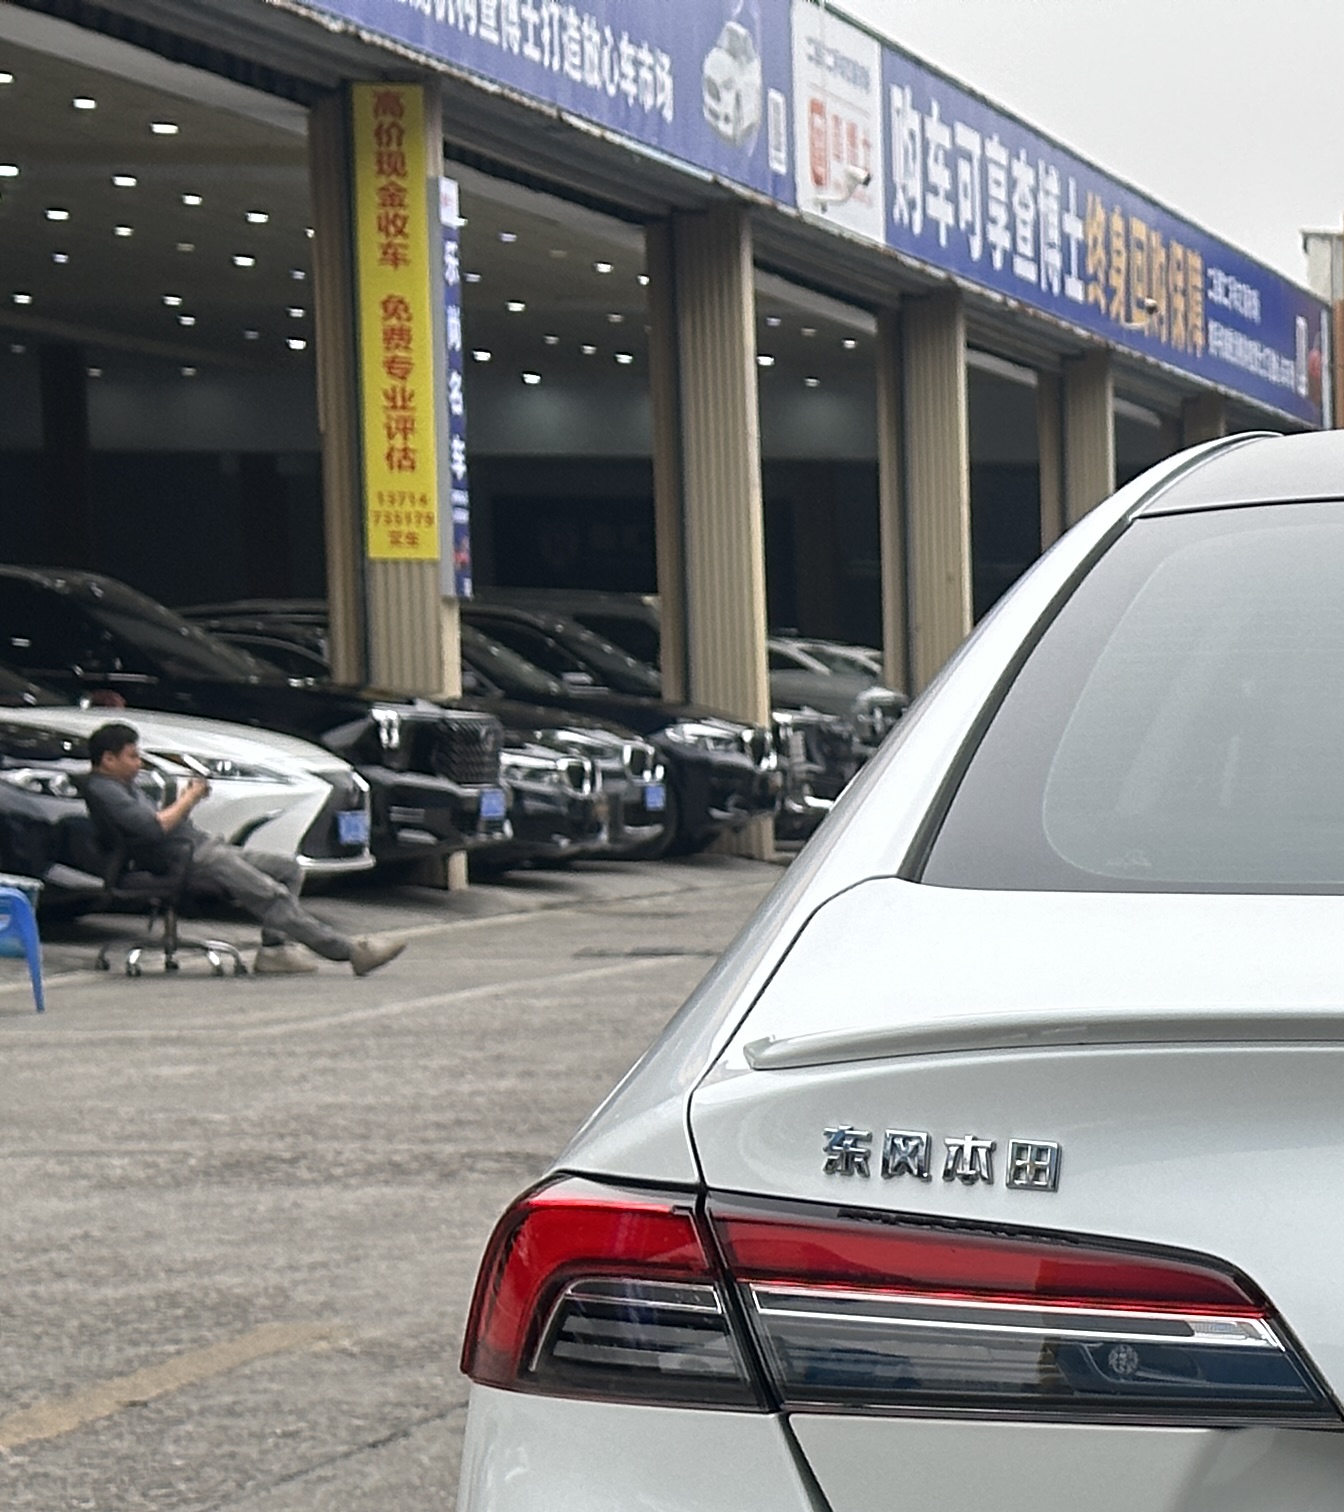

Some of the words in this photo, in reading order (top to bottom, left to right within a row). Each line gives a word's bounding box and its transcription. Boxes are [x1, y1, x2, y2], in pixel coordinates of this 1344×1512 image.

[373, 89, 410, 270] 高价现金收车
[380, 293, 417, 474] 免费专业评估
[821, 1124, 1063, 1193] 东风本田
